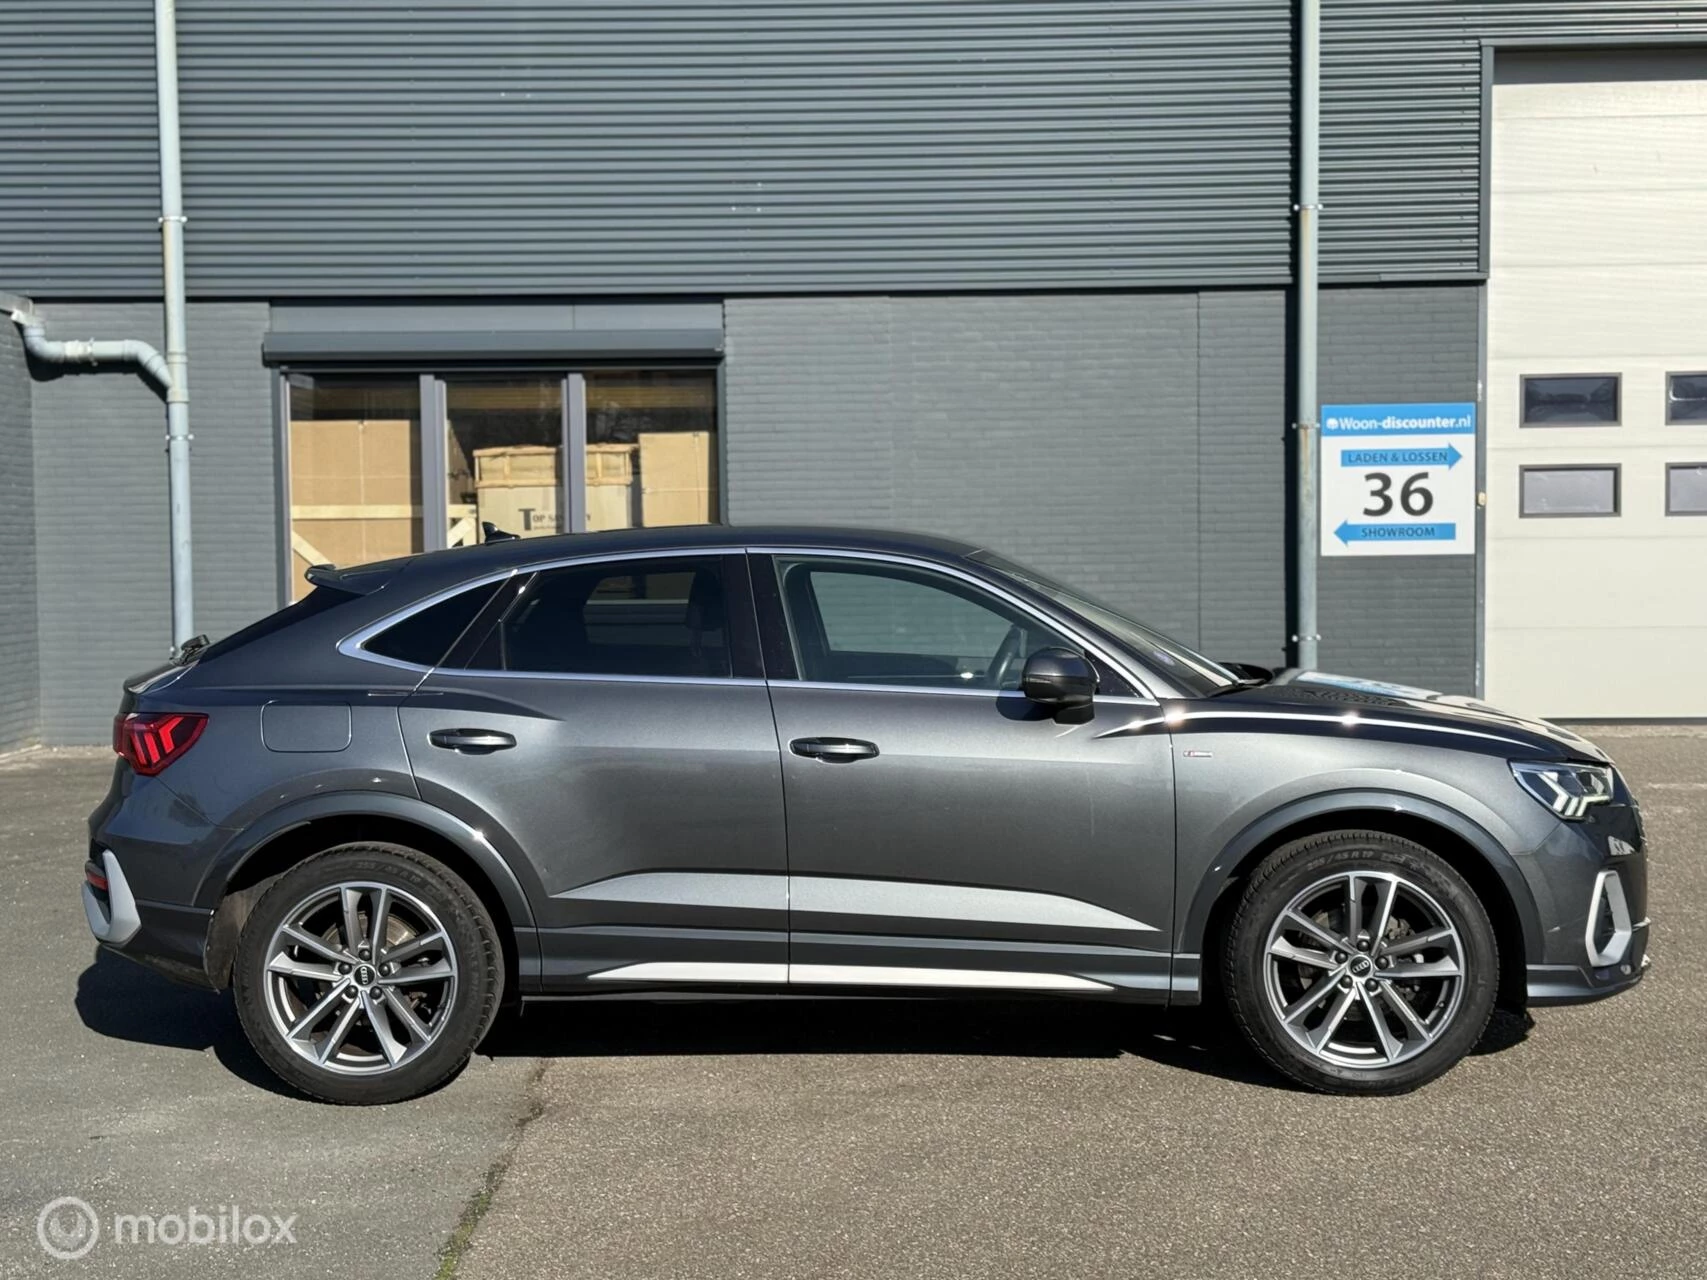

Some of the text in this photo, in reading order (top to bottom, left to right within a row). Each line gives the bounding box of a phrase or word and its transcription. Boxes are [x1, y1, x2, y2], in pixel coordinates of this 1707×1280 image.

[1340, 415, 1472, 430] Woon-discounter.nl
[1348, 451, 1448, 463] LADEN & LOSSEN
[1363, 472, 1434, 517] 36
[1361, 527, 1435, 538] SHOWROOM
